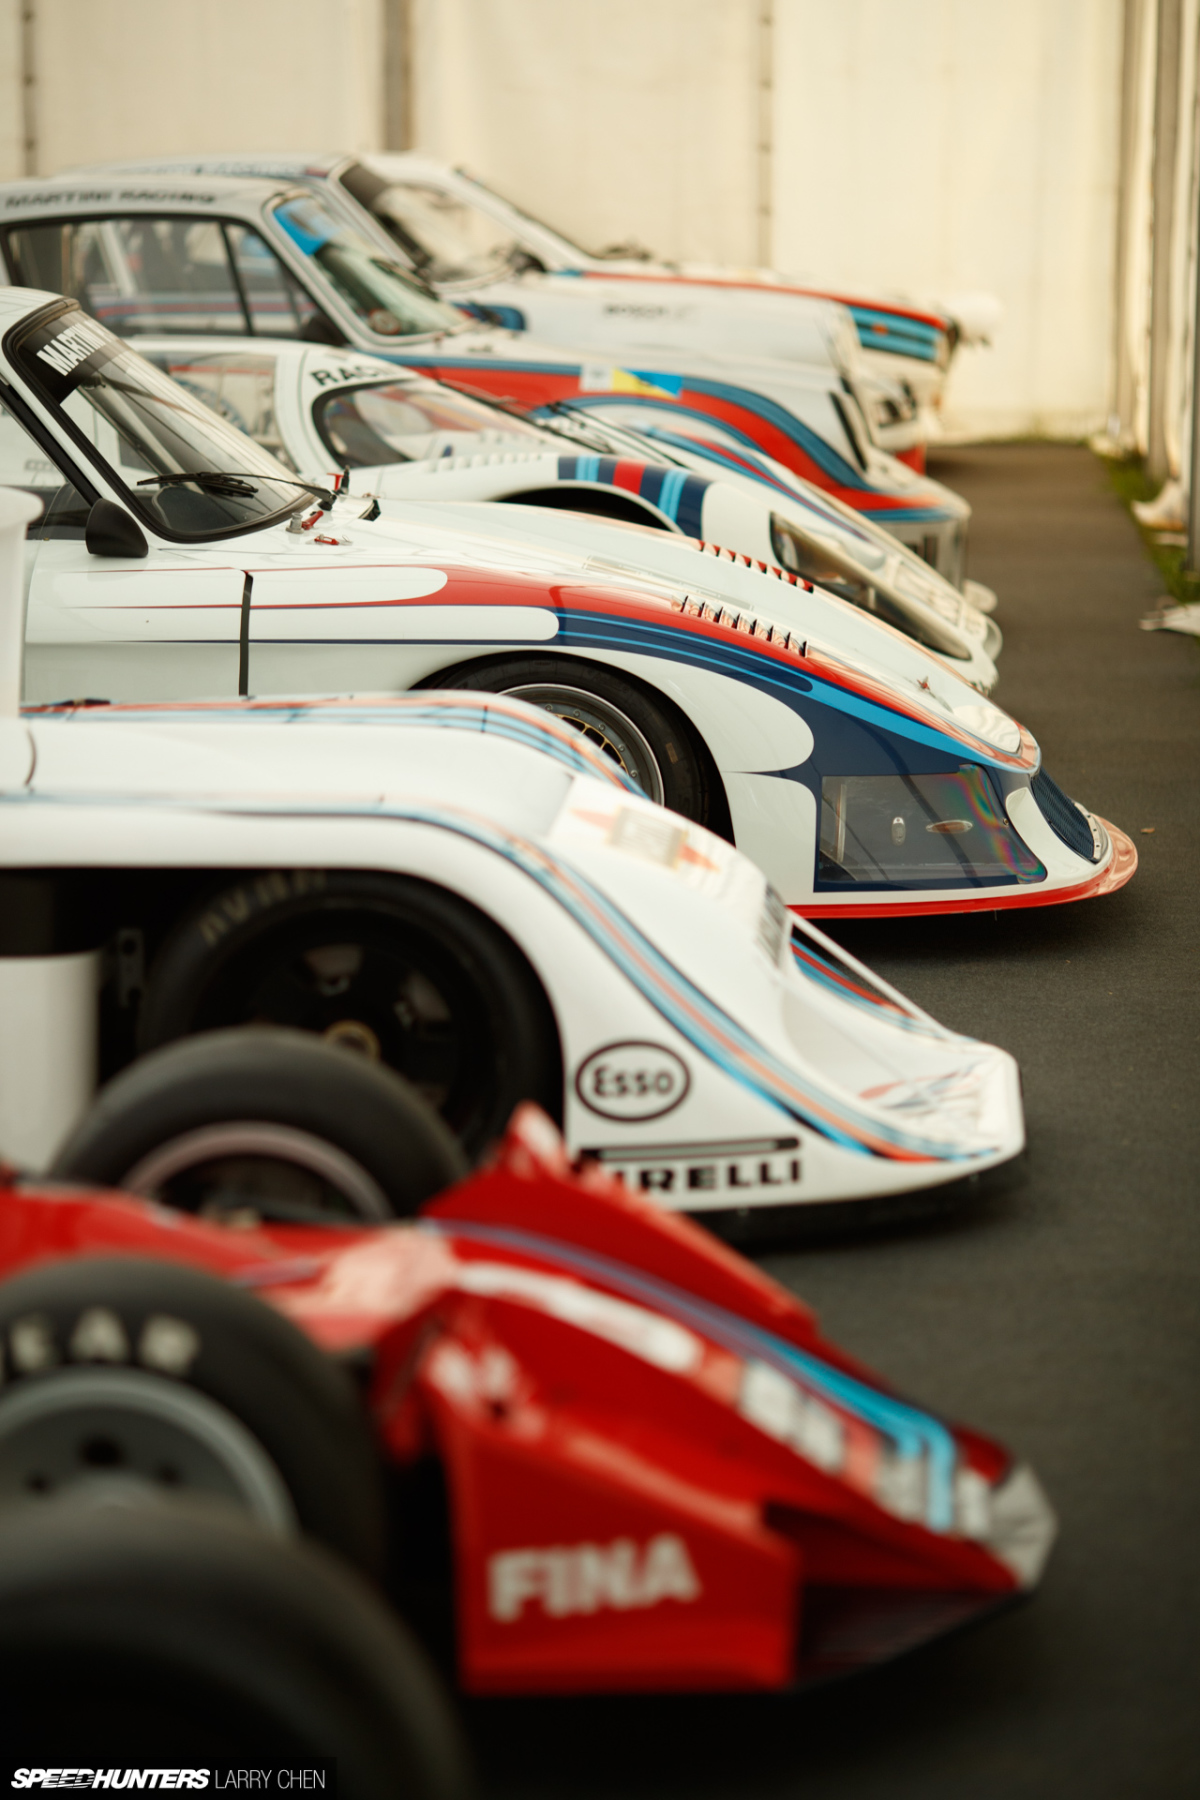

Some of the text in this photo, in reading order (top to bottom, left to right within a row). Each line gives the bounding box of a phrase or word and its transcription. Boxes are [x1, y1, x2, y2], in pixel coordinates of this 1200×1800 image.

[5, 189, 216, 208] MARTINI RACING
[36, 322, 106, 377] MARTINI
[593, 1065, 674, 1097] Esso
[0, 1306, 199, 1378] EAR
[488, 1532, 703, 1624] FINA
